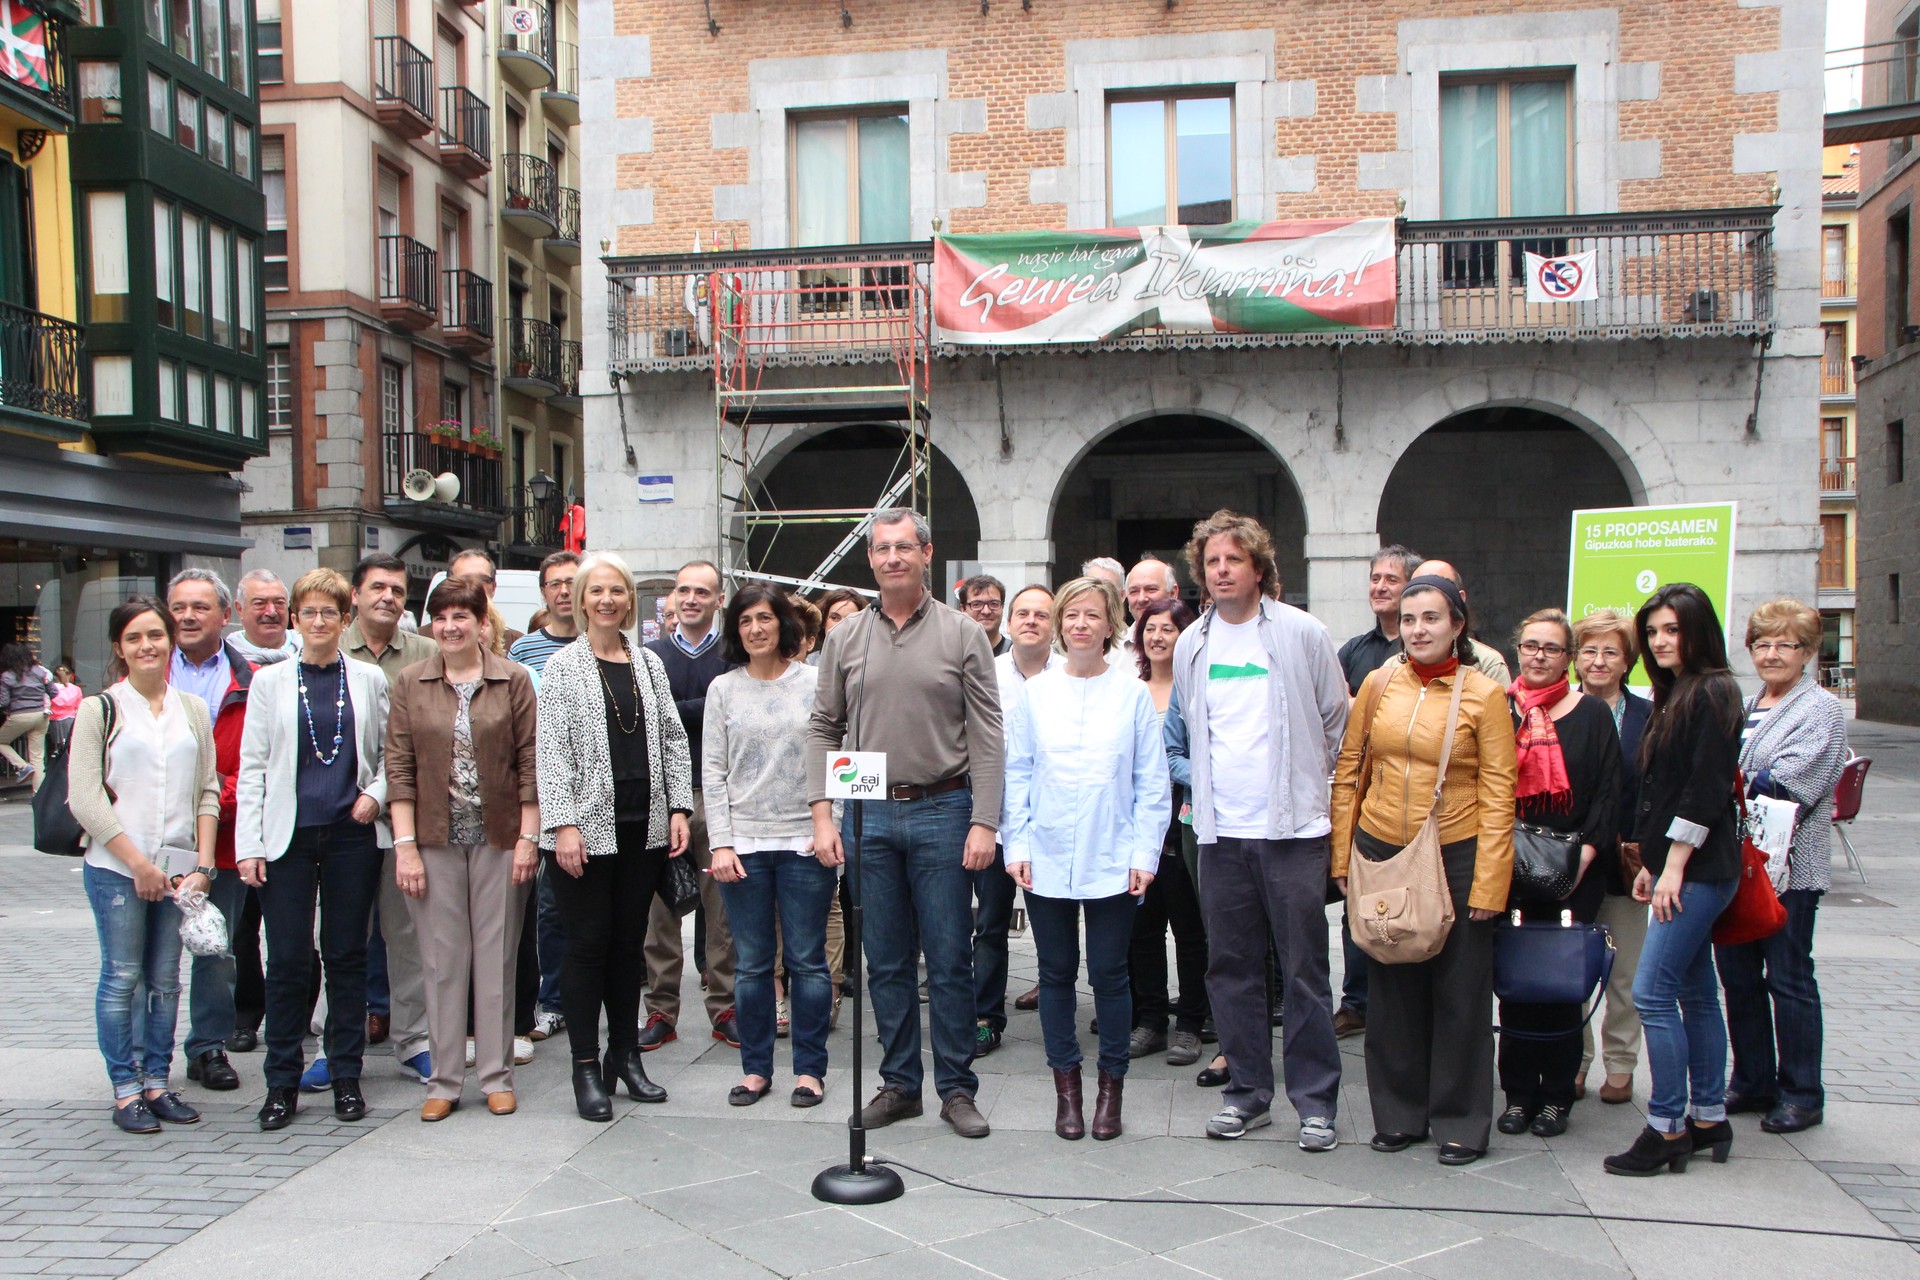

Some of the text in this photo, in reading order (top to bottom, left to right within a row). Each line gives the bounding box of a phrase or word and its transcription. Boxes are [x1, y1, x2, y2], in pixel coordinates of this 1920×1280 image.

[1017, 243, 1139, 273] nazio bat gara
[958, 238, 1377, 325] Geurea Ikurriña!
[1585, 518, 1719, 538] 15 PROPOSAMEN
[1584, 535, 1717, 551] Gipuzkoa hobe baterako.
[1641, 575, 1651, 589] 2
[861, 773, 880, 787] eaj
[851, 784, 875, 795] pnv
